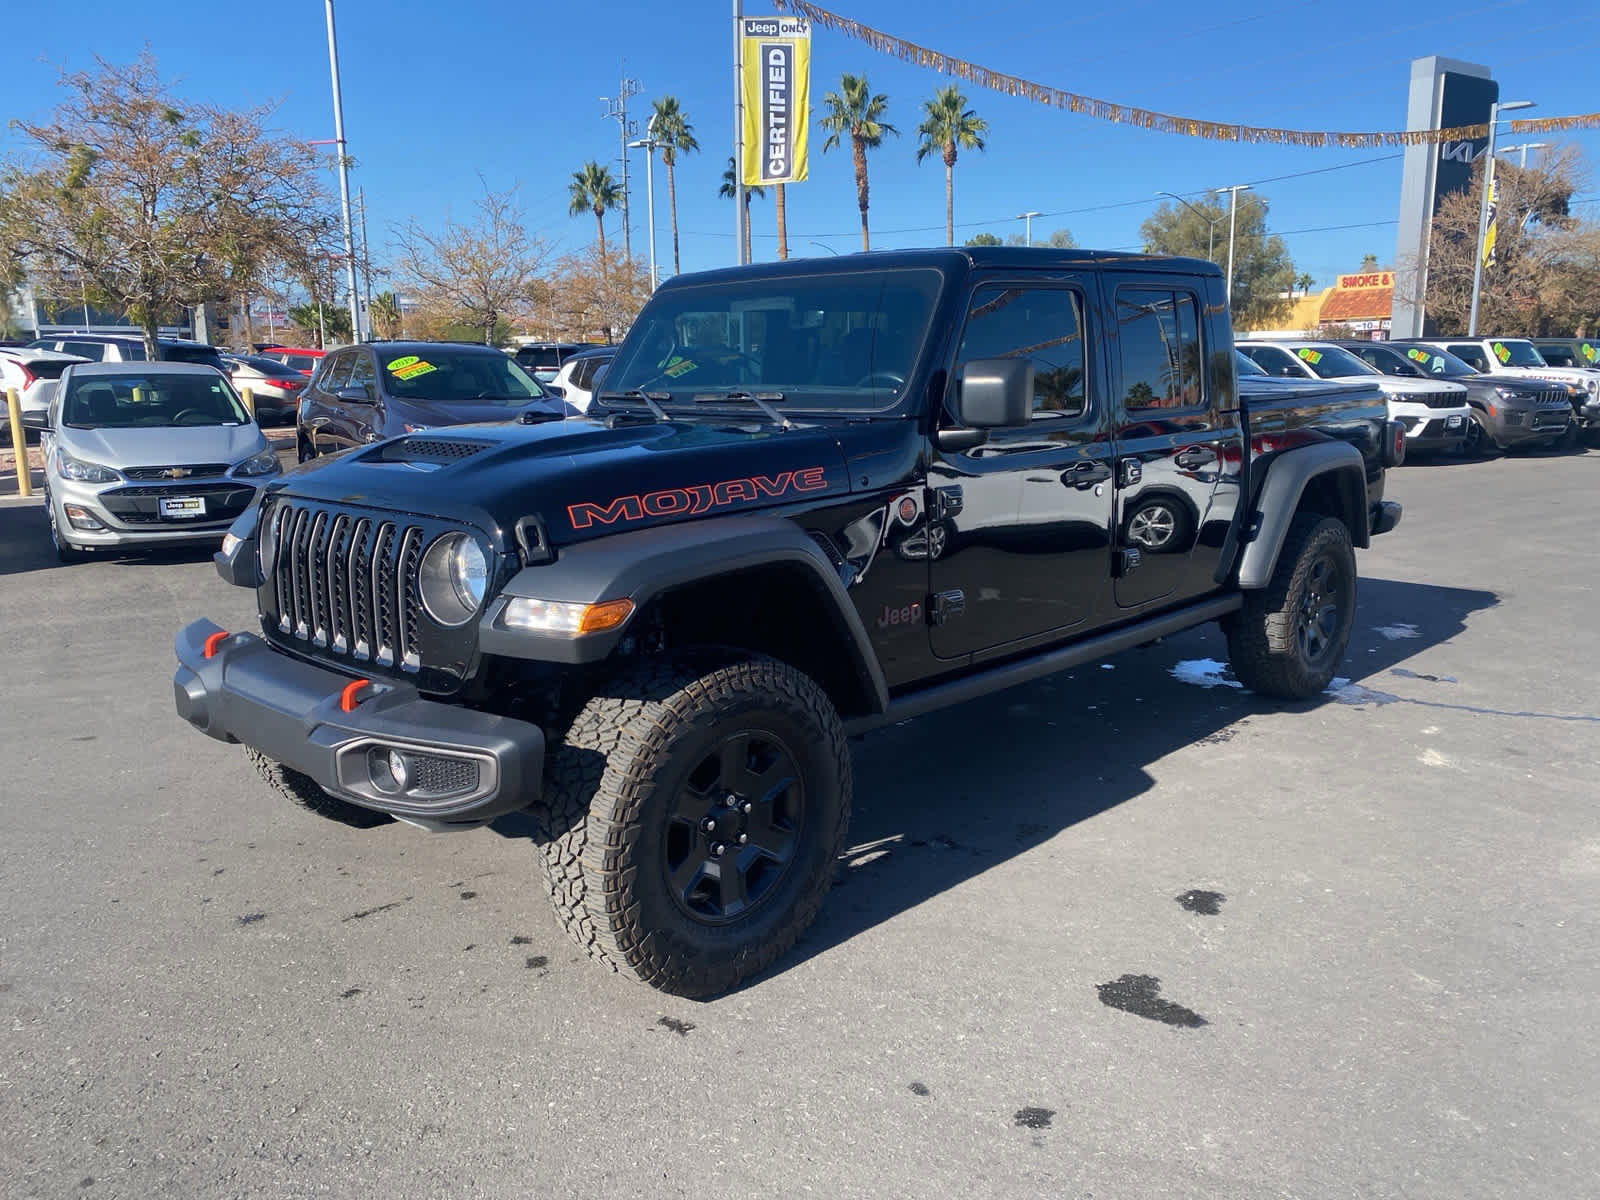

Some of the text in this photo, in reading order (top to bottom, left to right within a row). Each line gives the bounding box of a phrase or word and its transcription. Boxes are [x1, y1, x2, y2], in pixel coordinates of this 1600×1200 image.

[747, 21, 807, 35] Jeep ONLY
[768, 48, 786, 176] CERTIFIED
[1342, 274, 1379, 288] SMOKE
[567, 467, 828, 529] MOJAVE
[878, 601, 921, 627] Jeep
